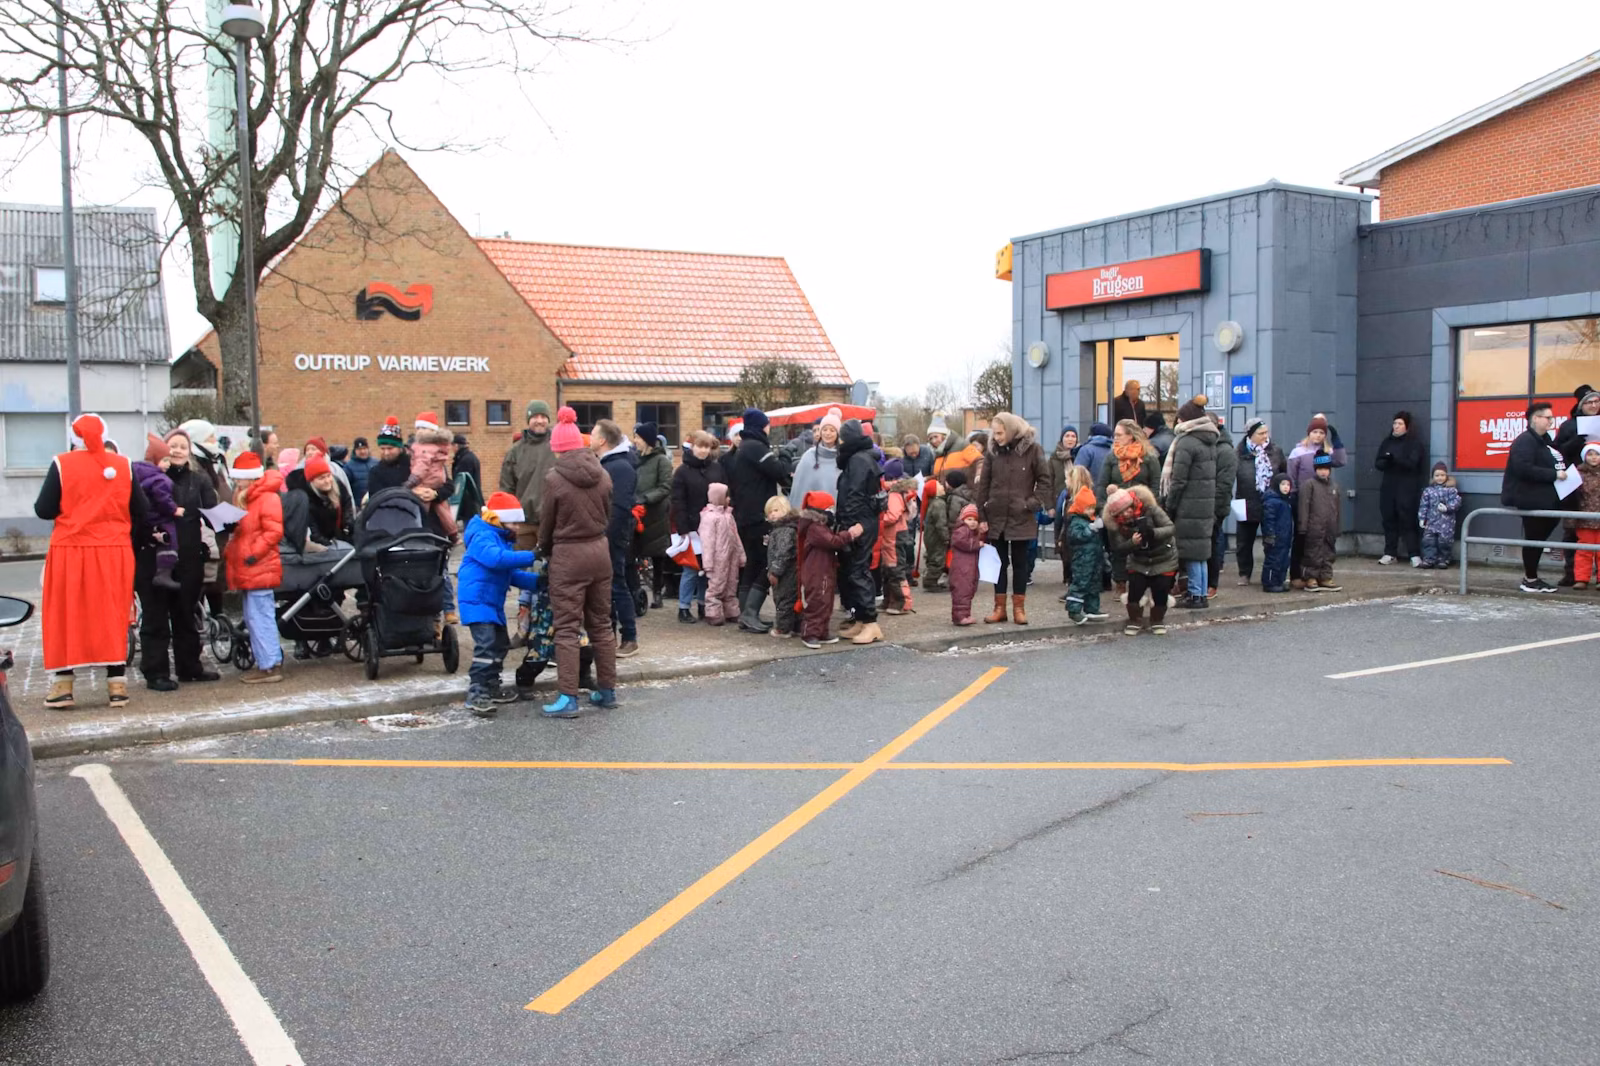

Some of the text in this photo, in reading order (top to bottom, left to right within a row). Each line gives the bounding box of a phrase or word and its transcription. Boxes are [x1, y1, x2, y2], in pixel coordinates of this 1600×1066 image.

[1093, 275, 1143, 297] Brugsen
[294, 354, 490, 372] OUTRUP VARMEVÆRK
